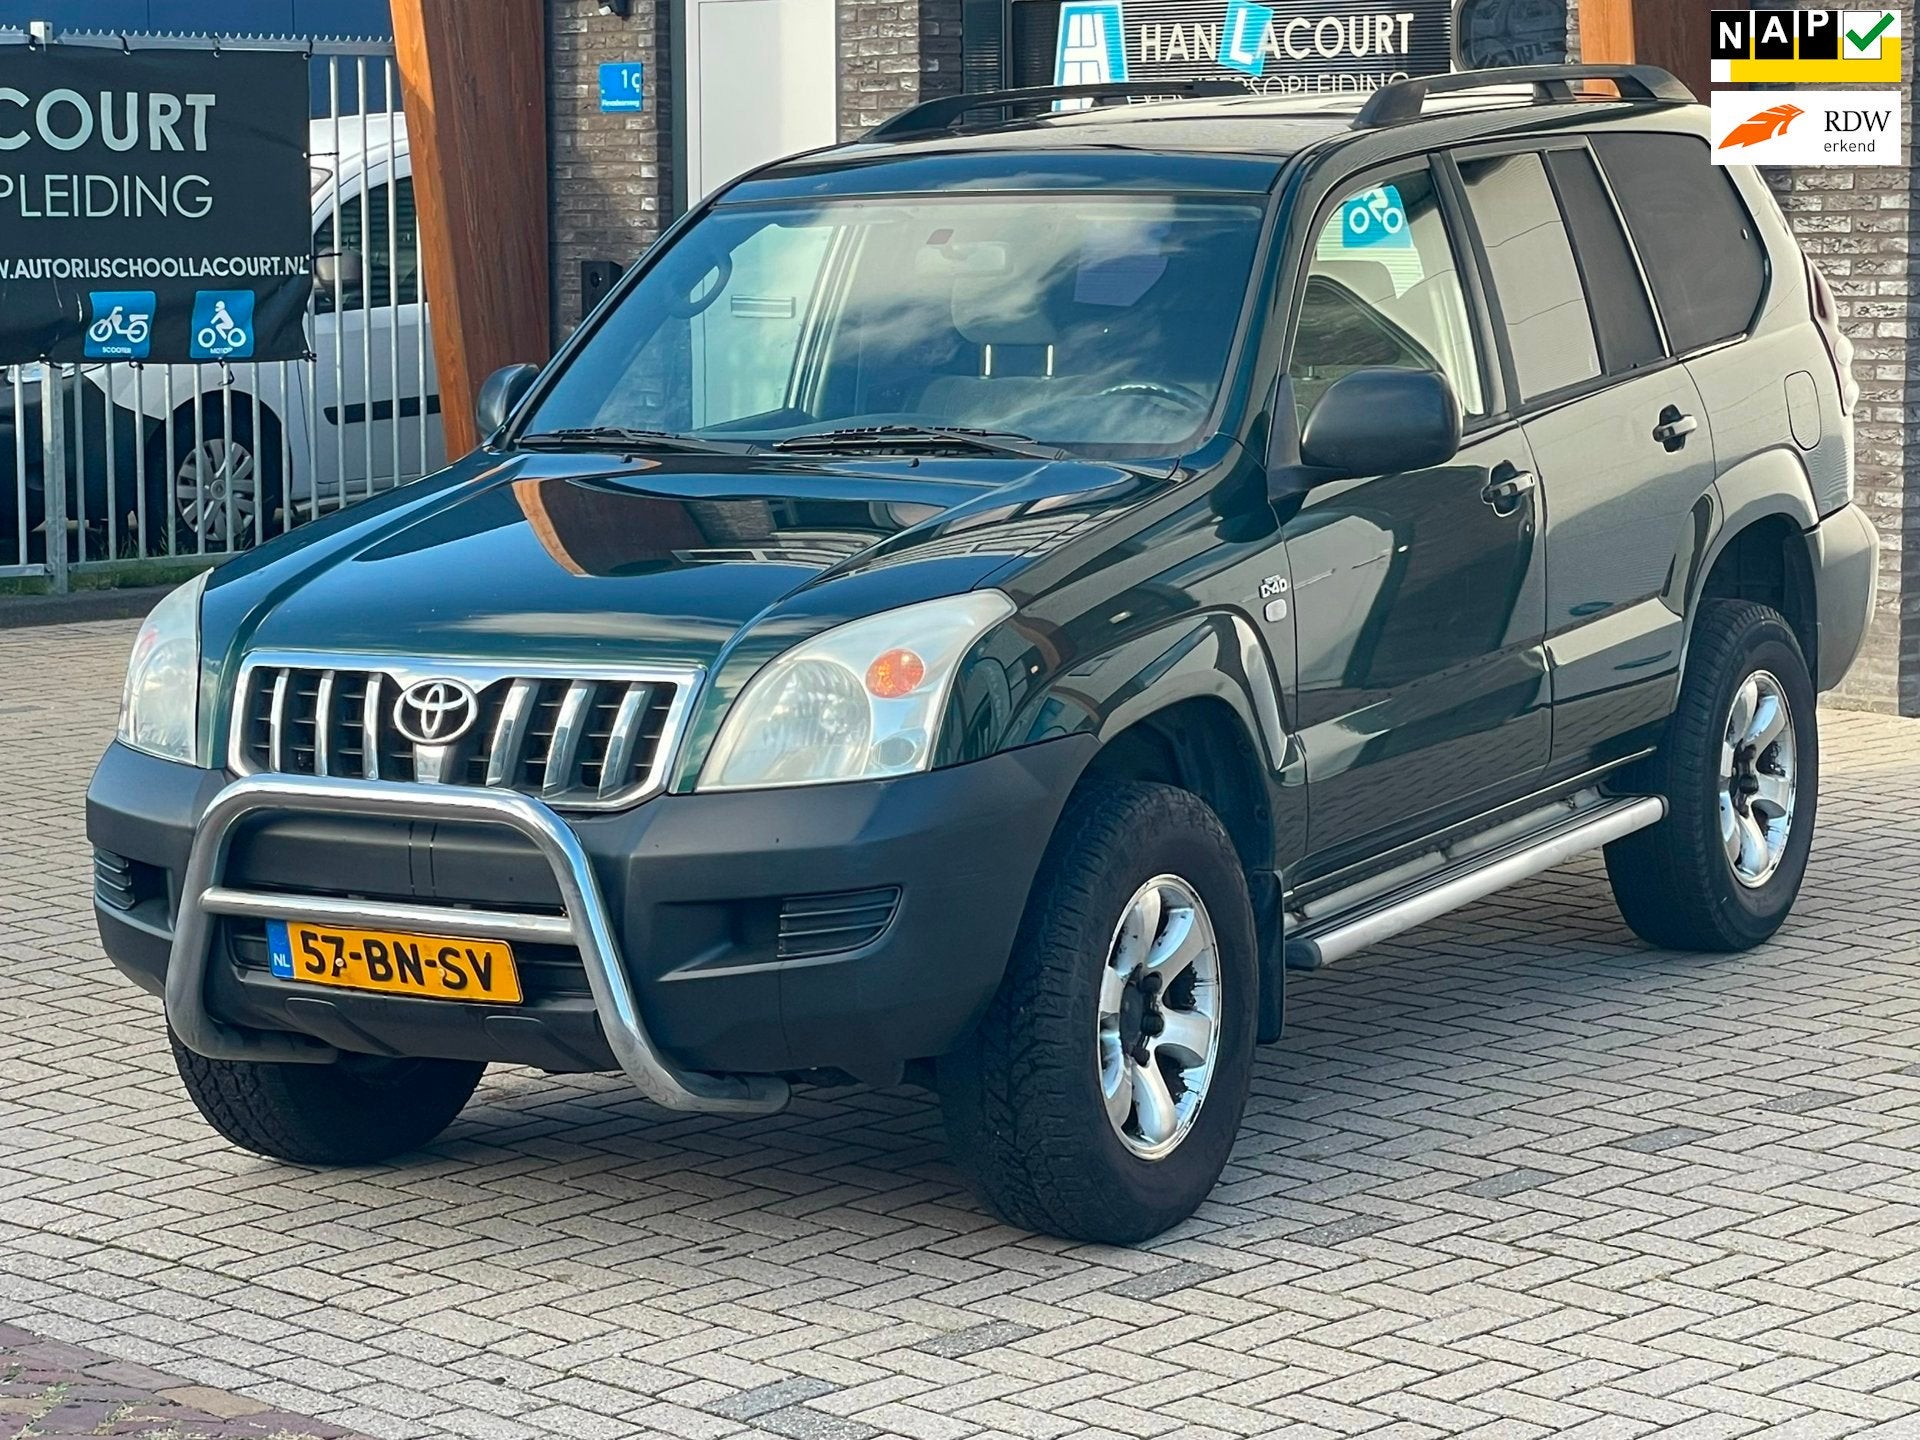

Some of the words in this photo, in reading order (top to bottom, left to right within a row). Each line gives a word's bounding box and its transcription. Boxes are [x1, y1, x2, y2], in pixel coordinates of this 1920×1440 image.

[1140, 23, 1216, 62] HAN
[1229, 7, 1414, 65] LACOURT
[273, 952, 291, 968] NL
[300, 929, 492, 992] 57-BN-SV
